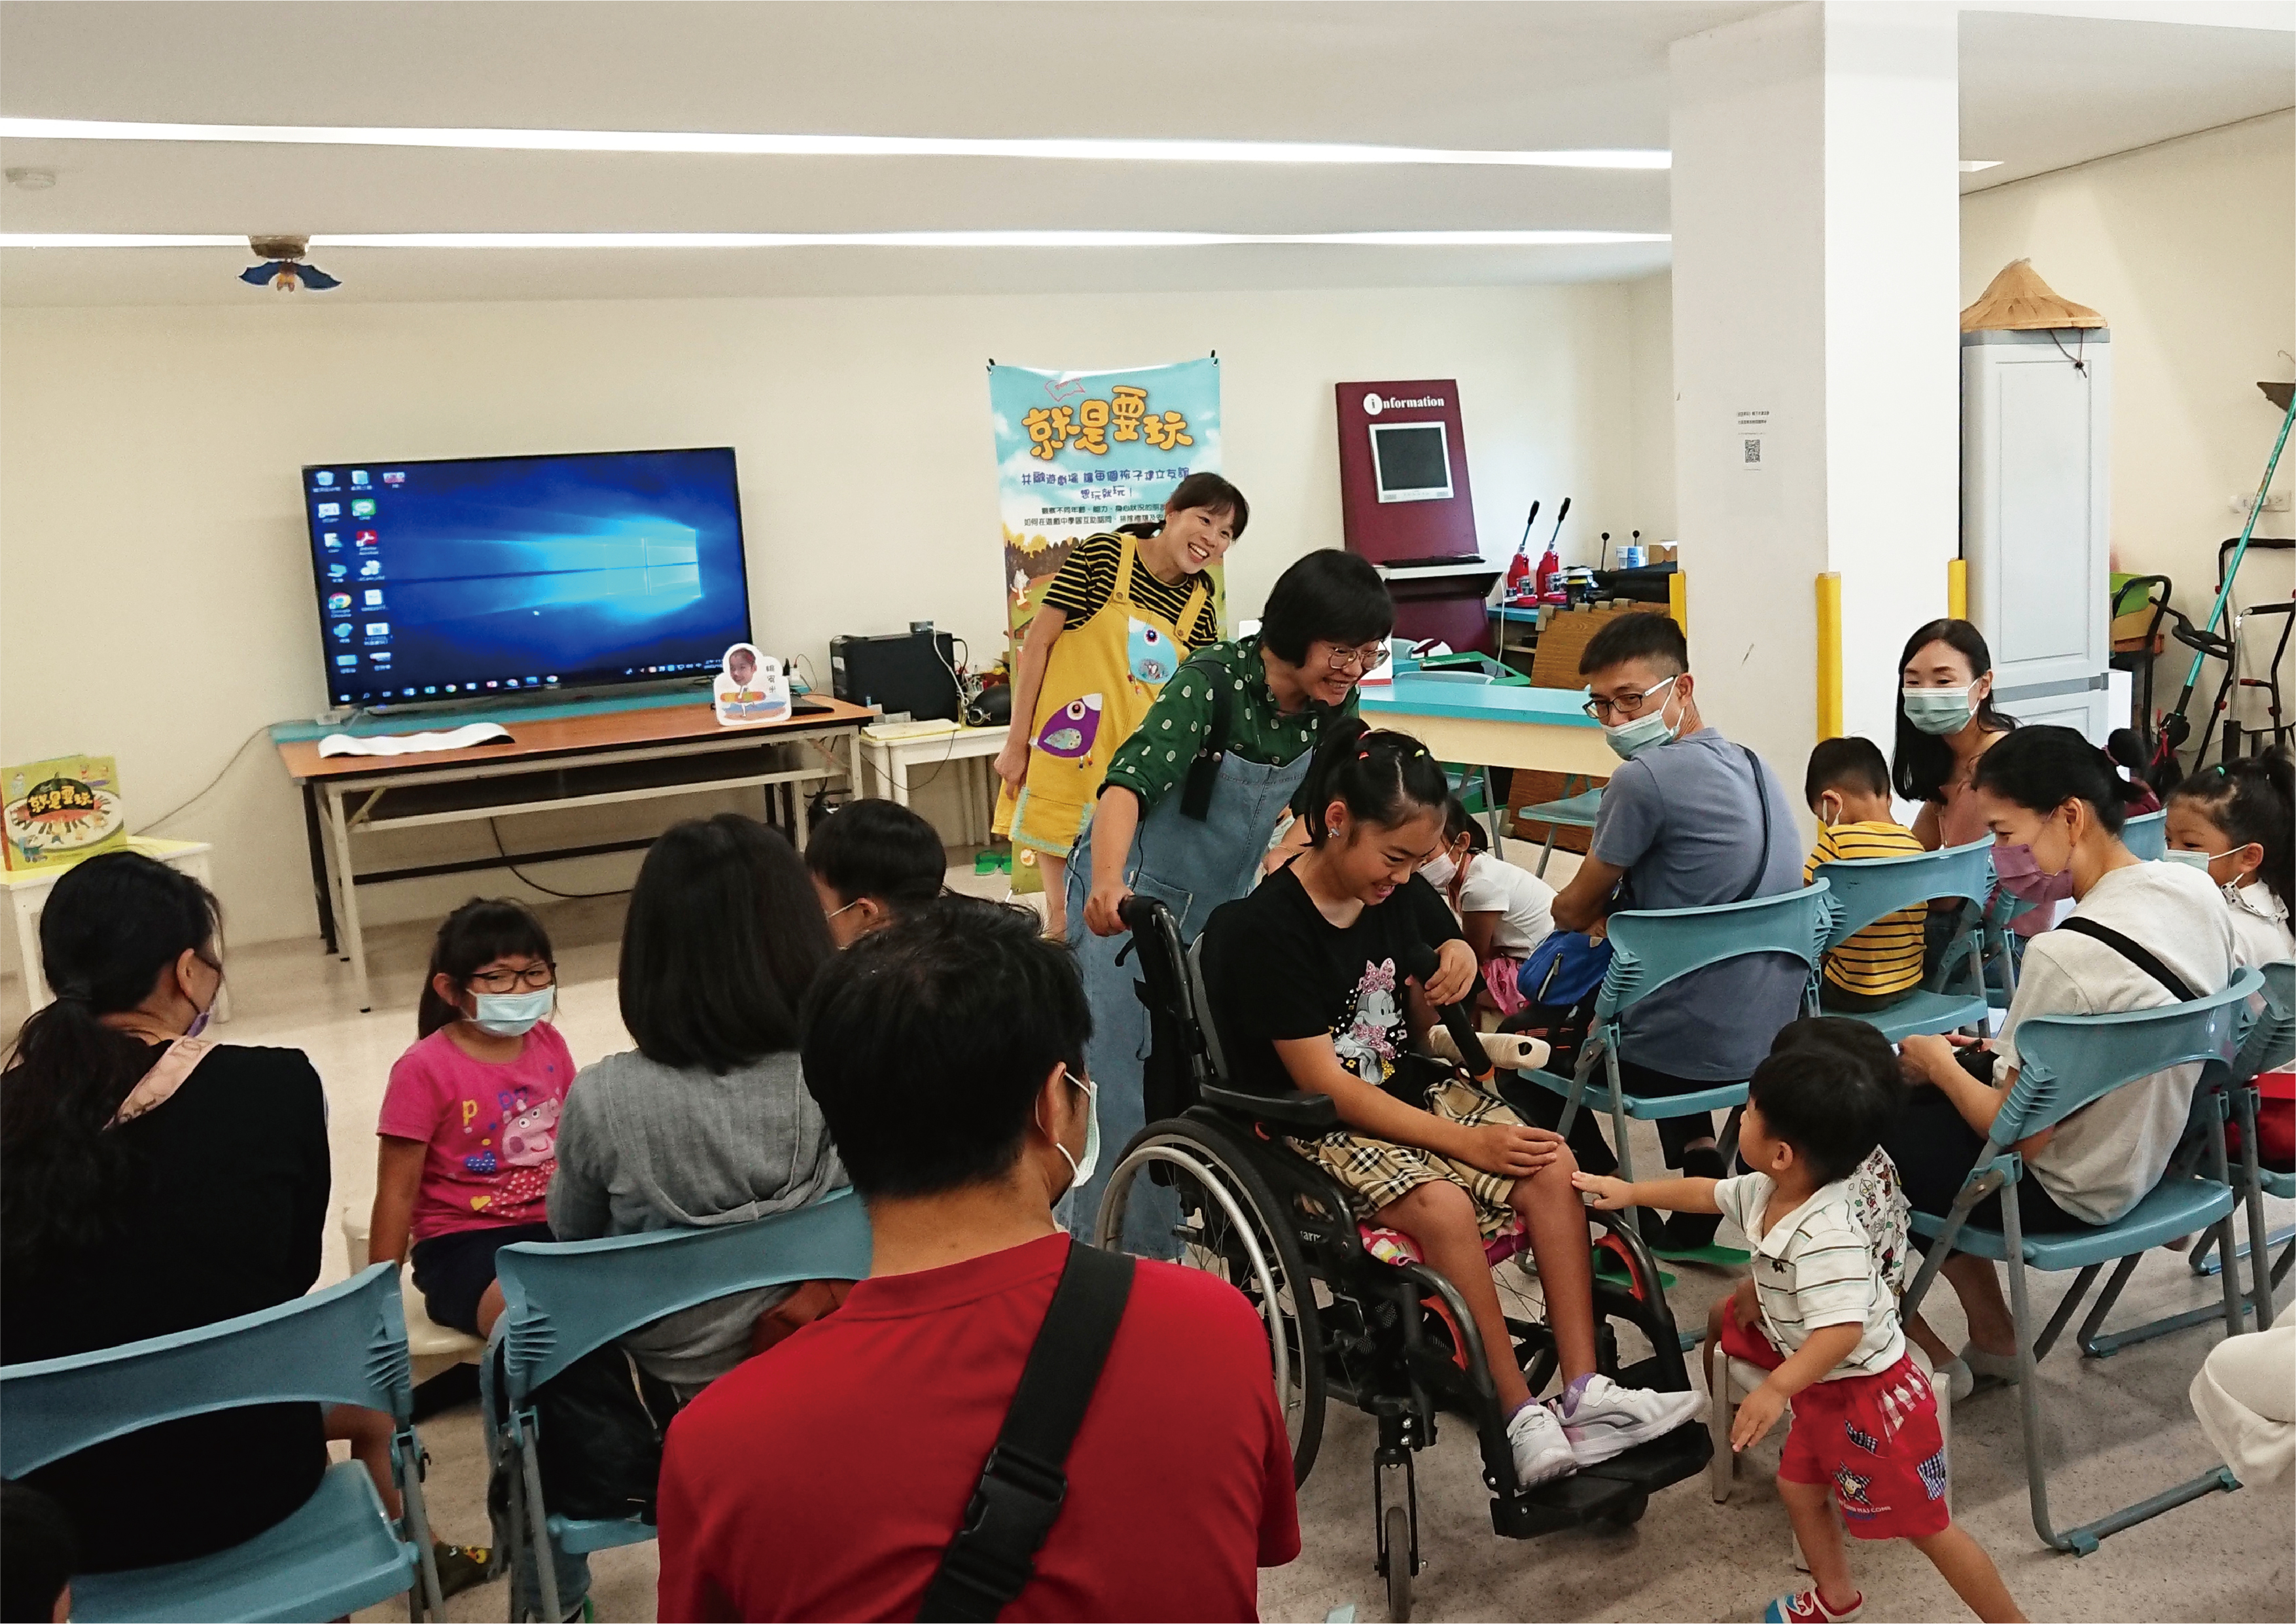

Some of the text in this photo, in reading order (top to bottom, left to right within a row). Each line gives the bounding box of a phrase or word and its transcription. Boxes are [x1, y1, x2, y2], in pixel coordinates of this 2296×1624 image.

[1021, 385, 1193, 461] 就是要玩
[1364, 393, 1445, 415] information
